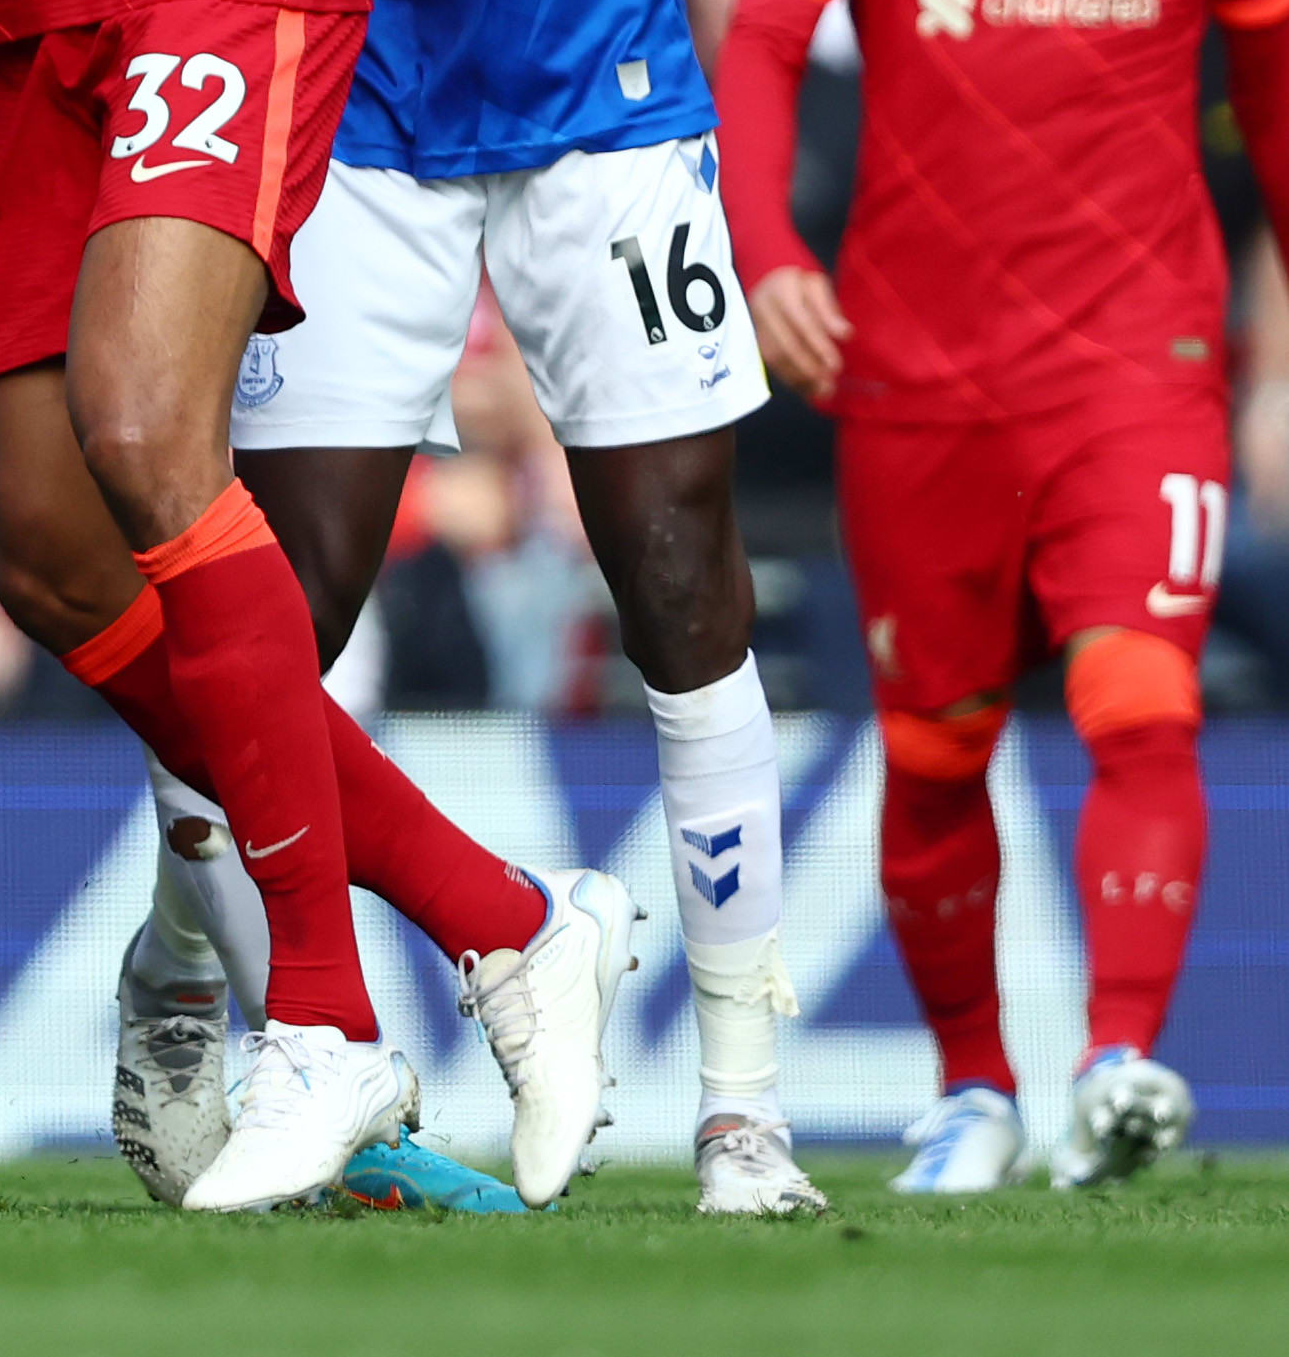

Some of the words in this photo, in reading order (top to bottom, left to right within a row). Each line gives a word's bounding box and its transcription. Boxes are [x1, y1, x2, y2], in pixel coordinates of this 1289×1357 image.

[110, 53, 247, 164] 32
[611, 220, 726, 346] 16
[1159, 472, 1226, 590] 11
